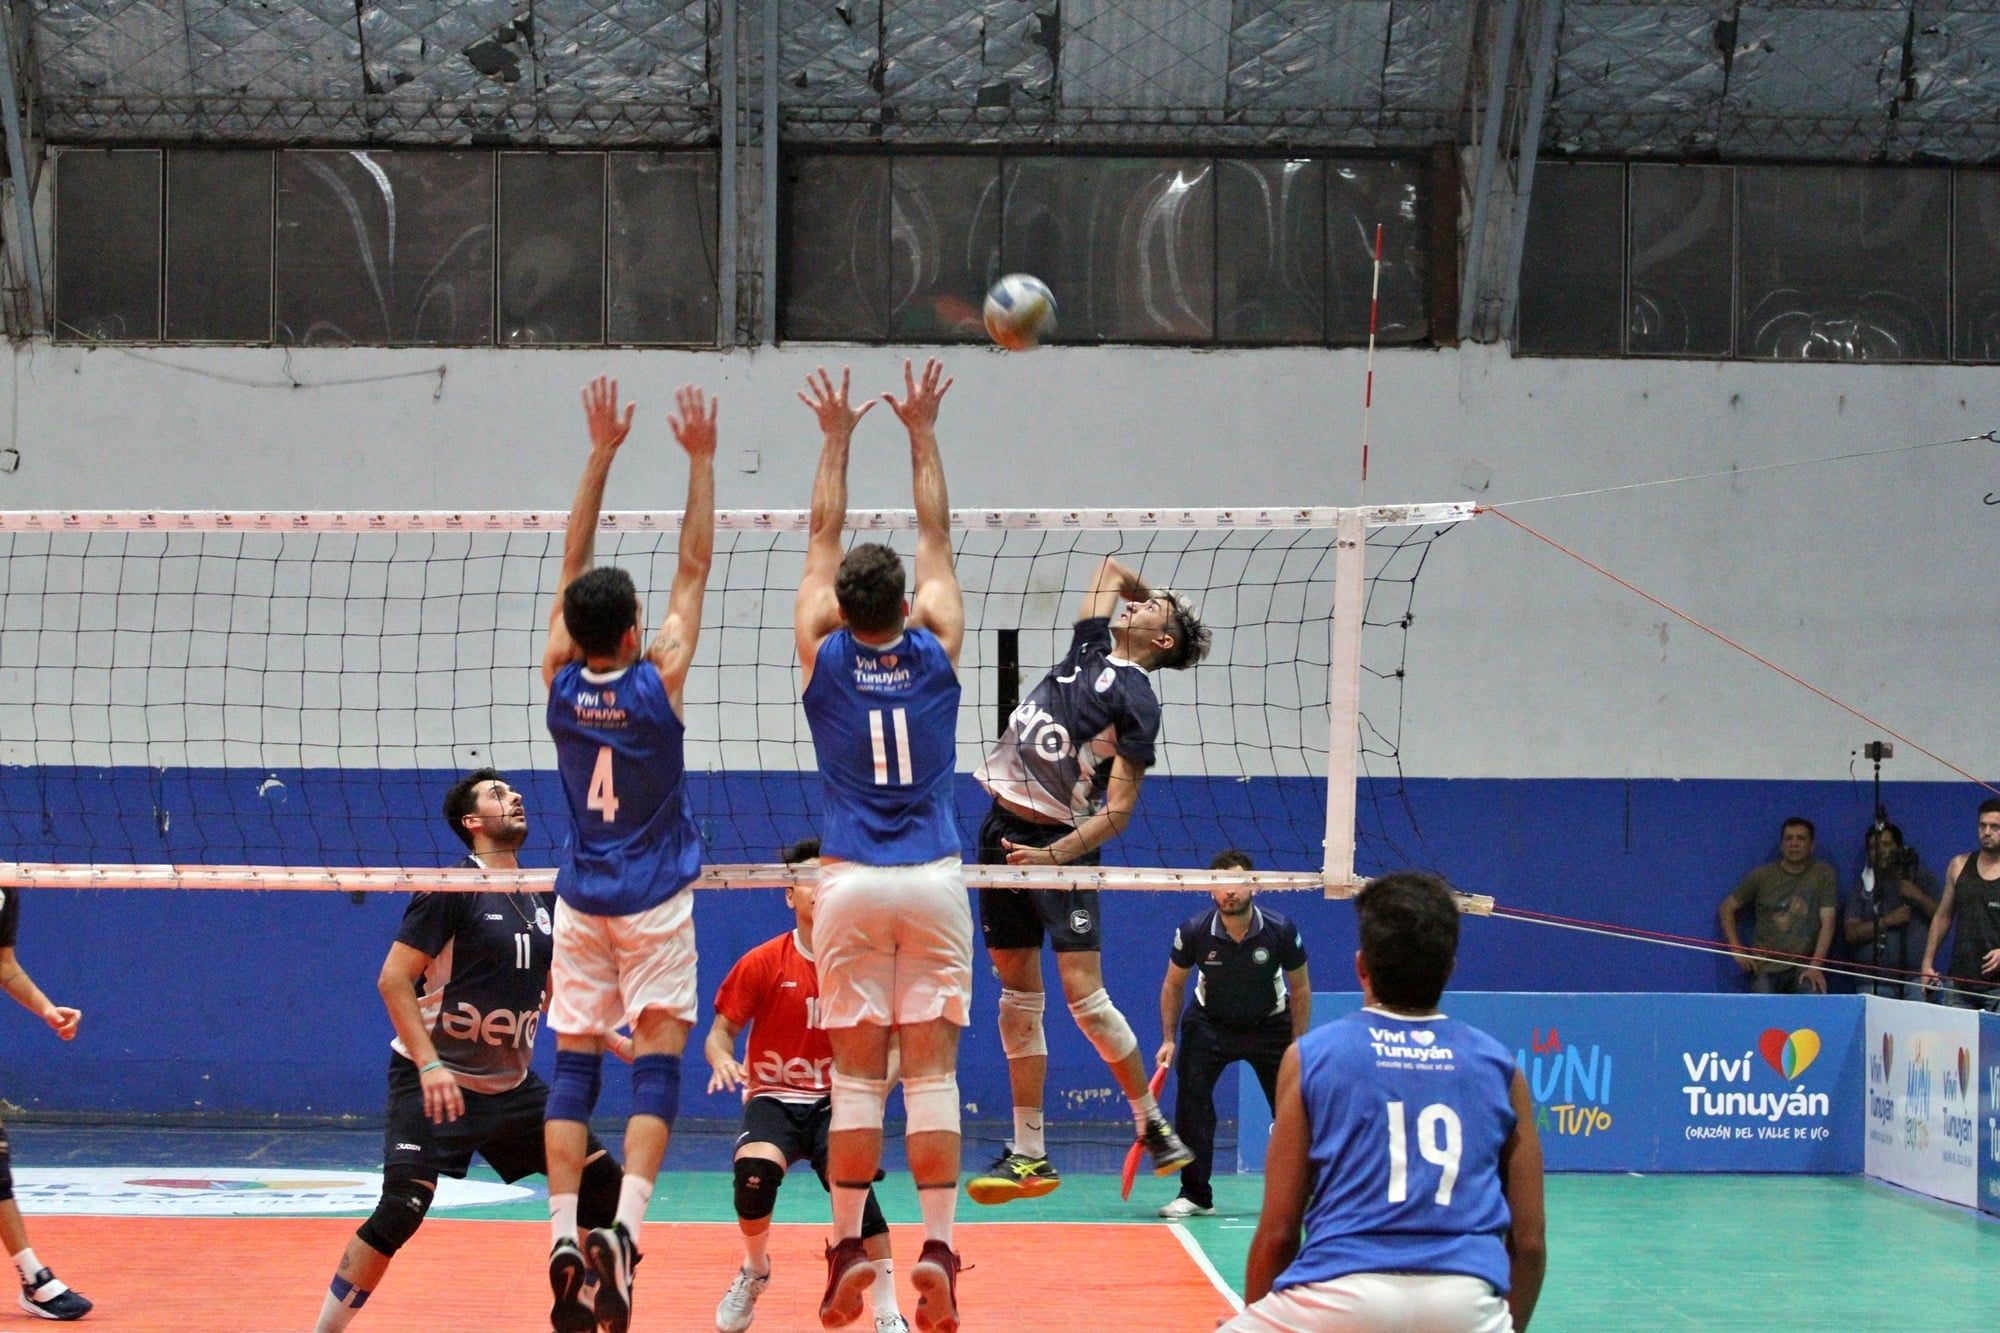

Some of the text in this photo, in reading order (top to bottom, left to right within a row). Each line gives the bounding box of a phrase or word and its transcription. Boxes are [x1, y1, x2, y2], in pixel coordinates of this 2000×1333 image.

[869, 708, 913, 785] 11
[587, 746, 619, 823] 4
[514, 933, 531, 969] 11
[442, 1001, 541, 1049] aero
[1532, 1027, 1561, 1056] LA
[753, 1051, 832, 1089] aer
[1371, 1042, 1453, 1062] Tunuyán
[1683, 1051, 1753, 1082] Viví
[1551, 1104, 1612, 1136] TUYO
[1682, 1085, 1829, 1121] Tunuyán
[1869, 1089, 1894, 1125] Tunuyán
[1735, 1127, 1754, 1139] DEL
[1757, 1126, 1790, 1139] VALLE
[1794, 1127, 1807, 1139] DE
[1943, 1107, 1973, 1146] Tunuyán
[1386, 1101, 1462, 1206] 19
